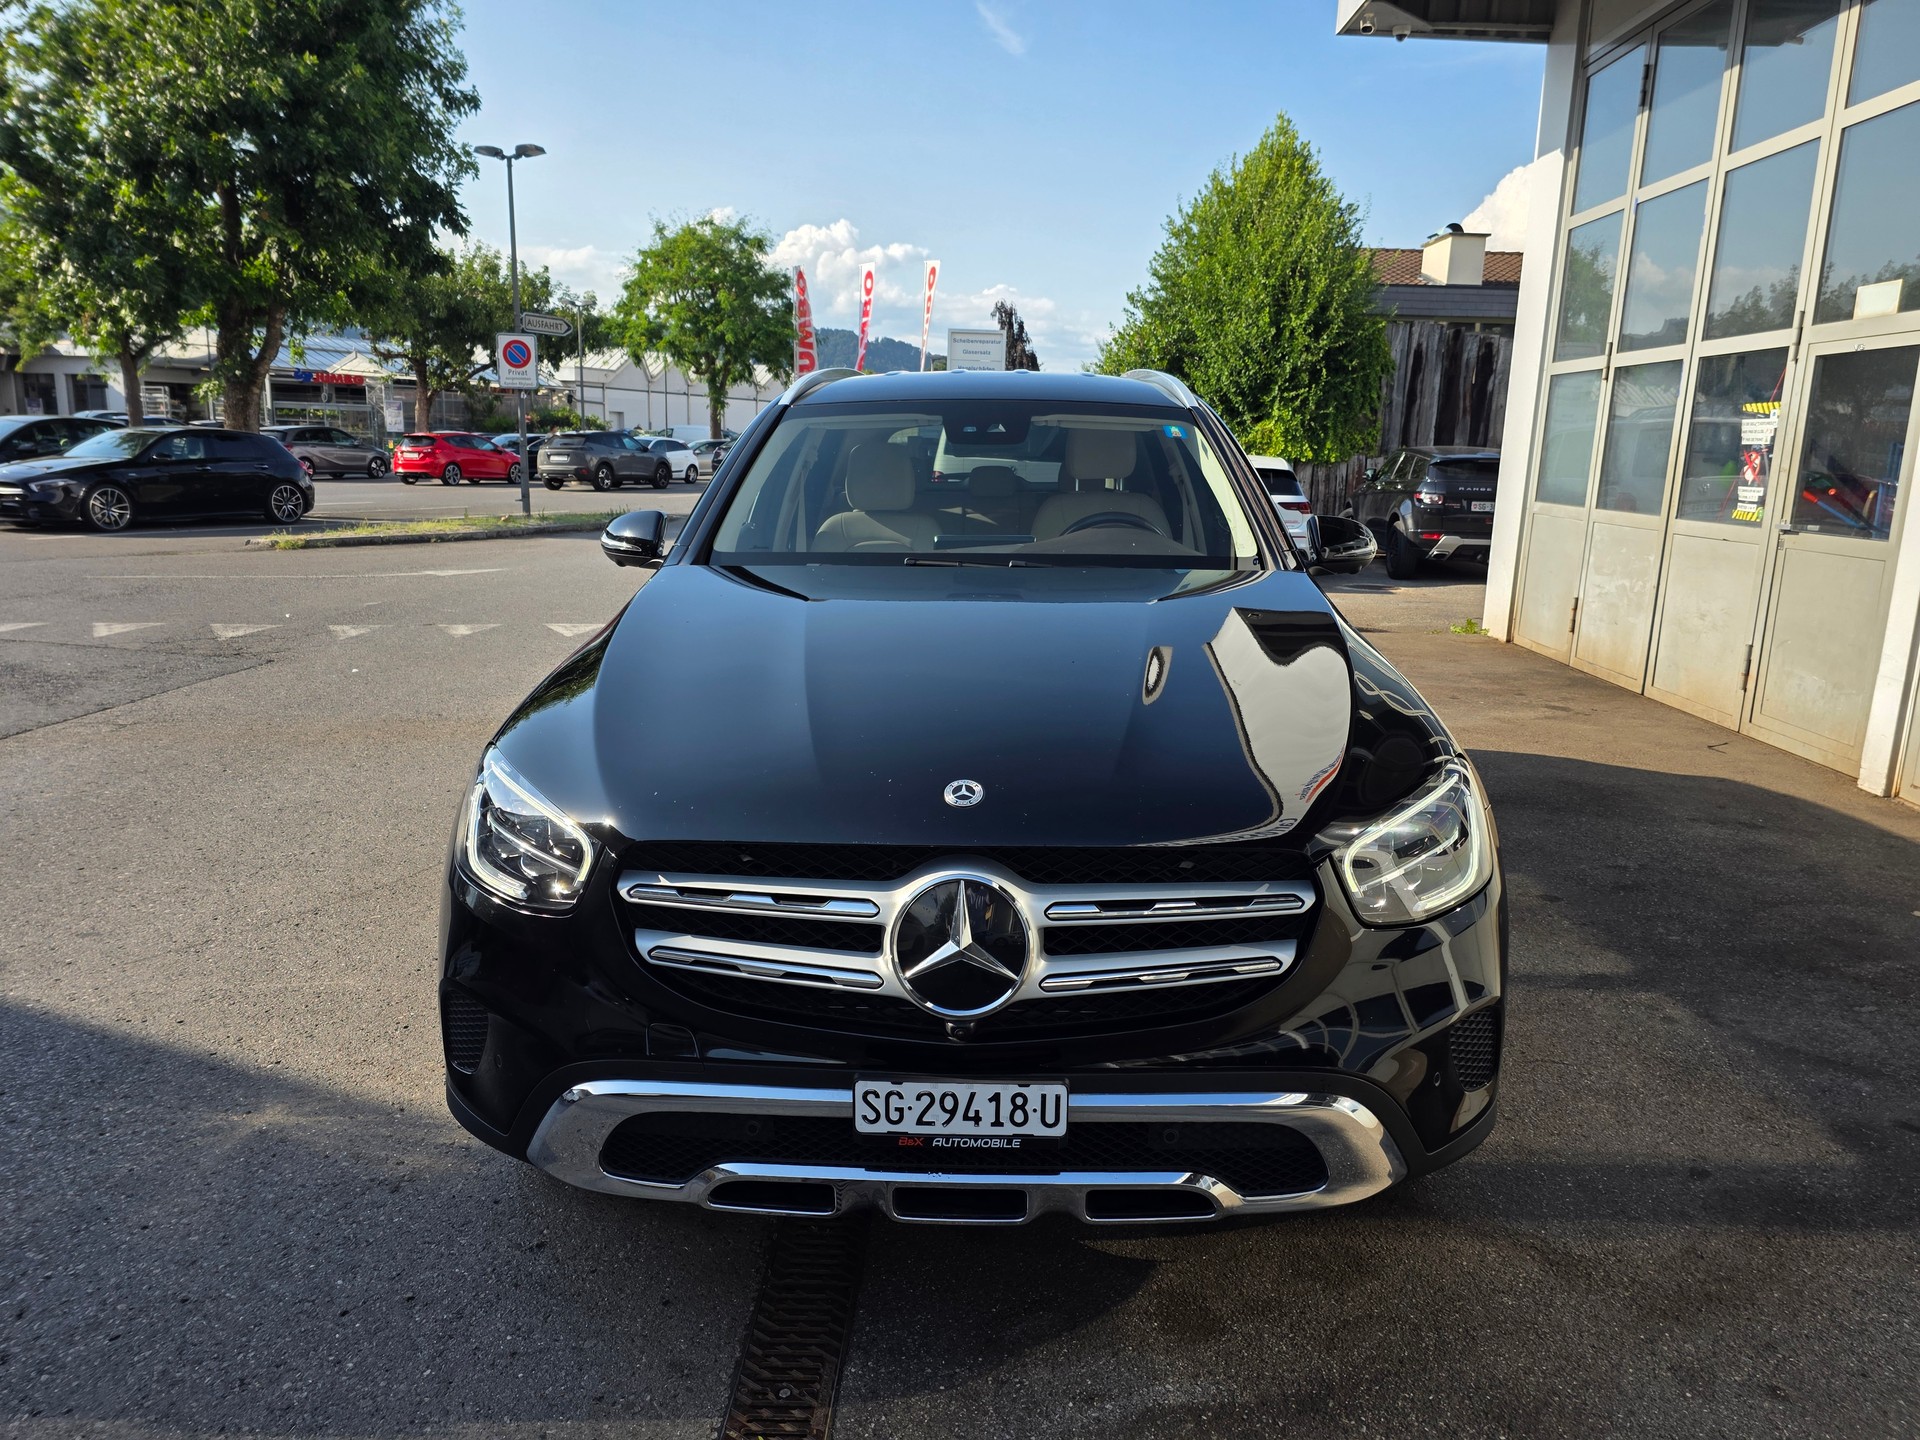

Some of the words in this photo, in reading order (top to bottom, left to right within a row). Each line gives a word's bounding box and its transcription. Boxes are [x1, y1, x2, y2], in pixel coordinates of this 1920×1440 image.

[526, 319, 563, 331] AUSFAHRT
[797, 271, 816, 374] UMBO
[507, 368, 528, 376] Privat
[898, 1137, 924, 1146] B&X
[932, 1137, 1022, 1148] AUTOMOBILE
